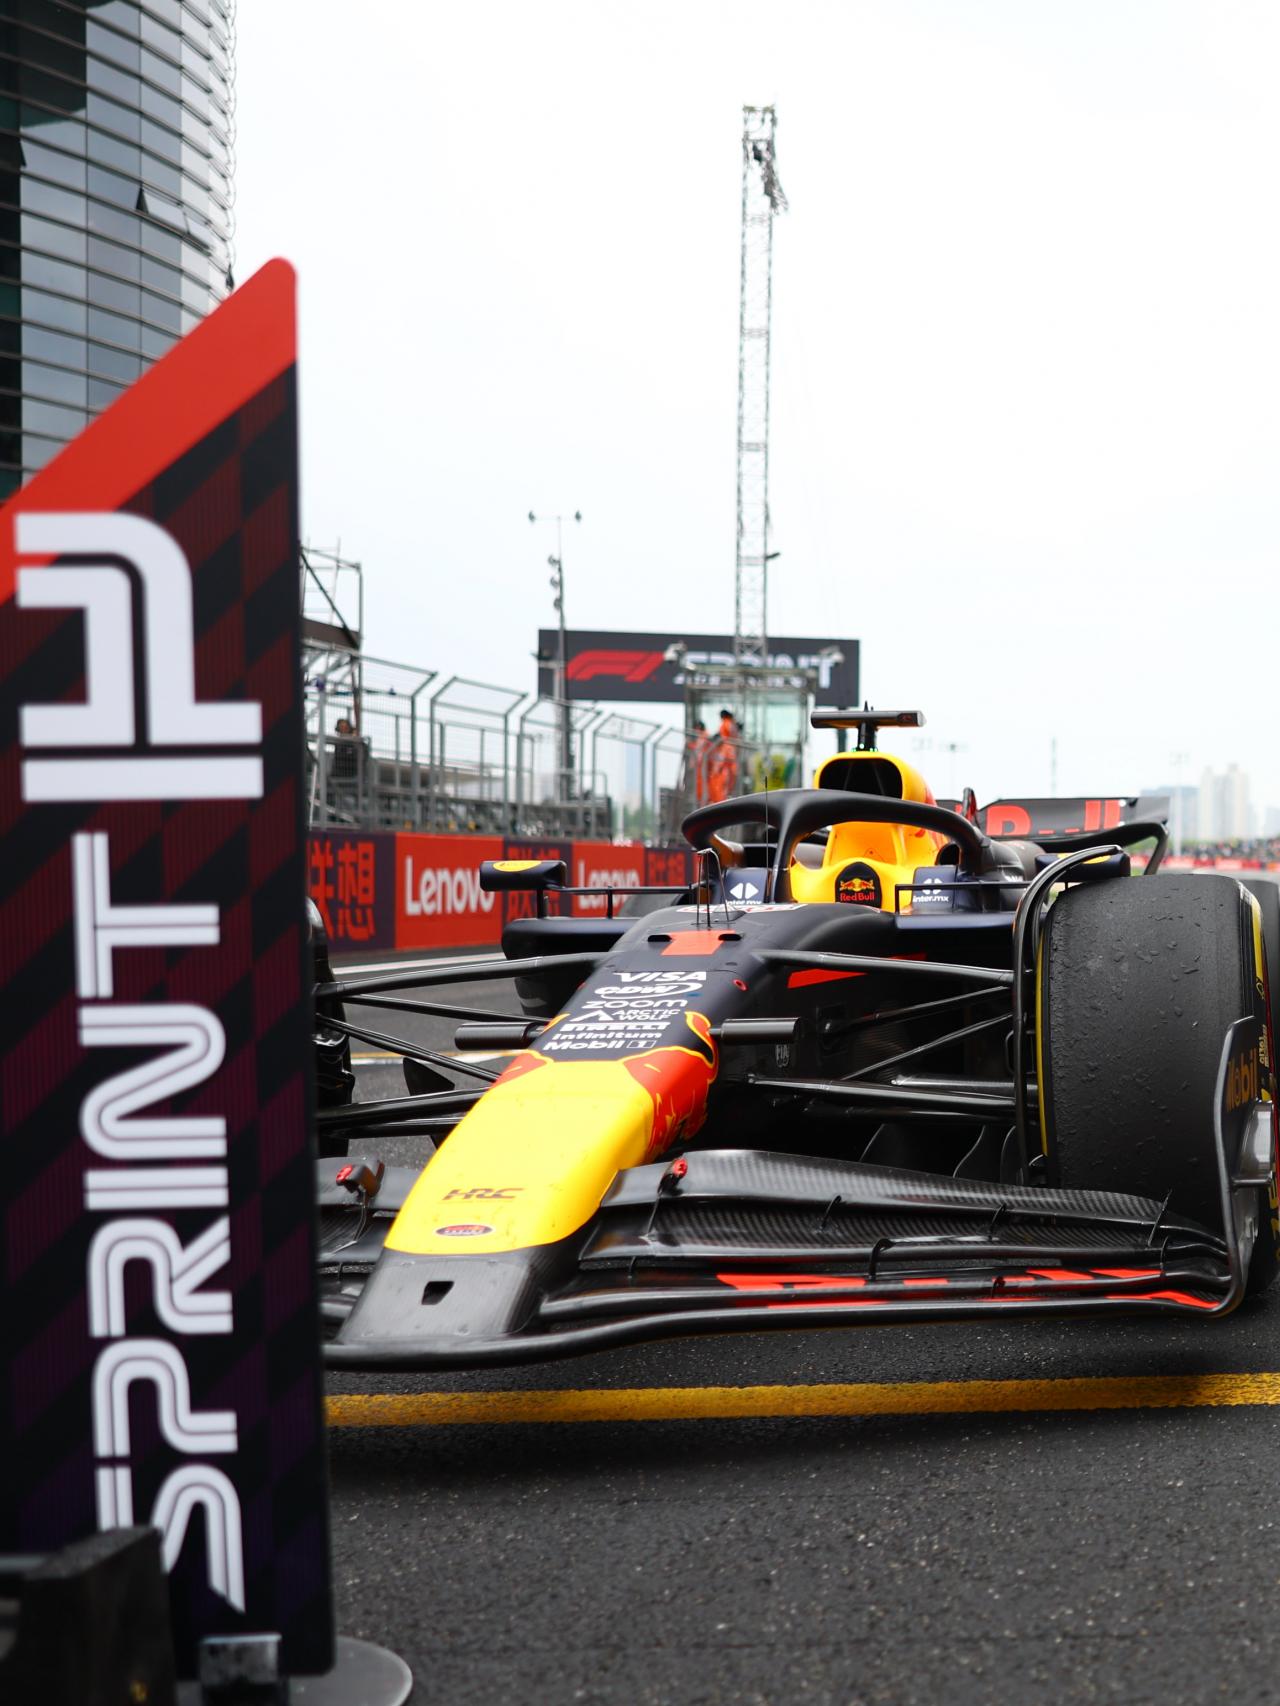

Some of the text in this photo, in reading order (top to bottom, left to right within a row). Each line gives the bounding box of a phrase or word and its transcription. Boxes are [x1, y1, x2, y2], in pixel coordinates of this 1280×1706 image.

[840, 890, 875, 901] Red Bull
[613, 971, 707, 983] VISA
[559, 1022, 671, 1032] PIRELLI
[542, 1040, 622, 1051] Mobil
